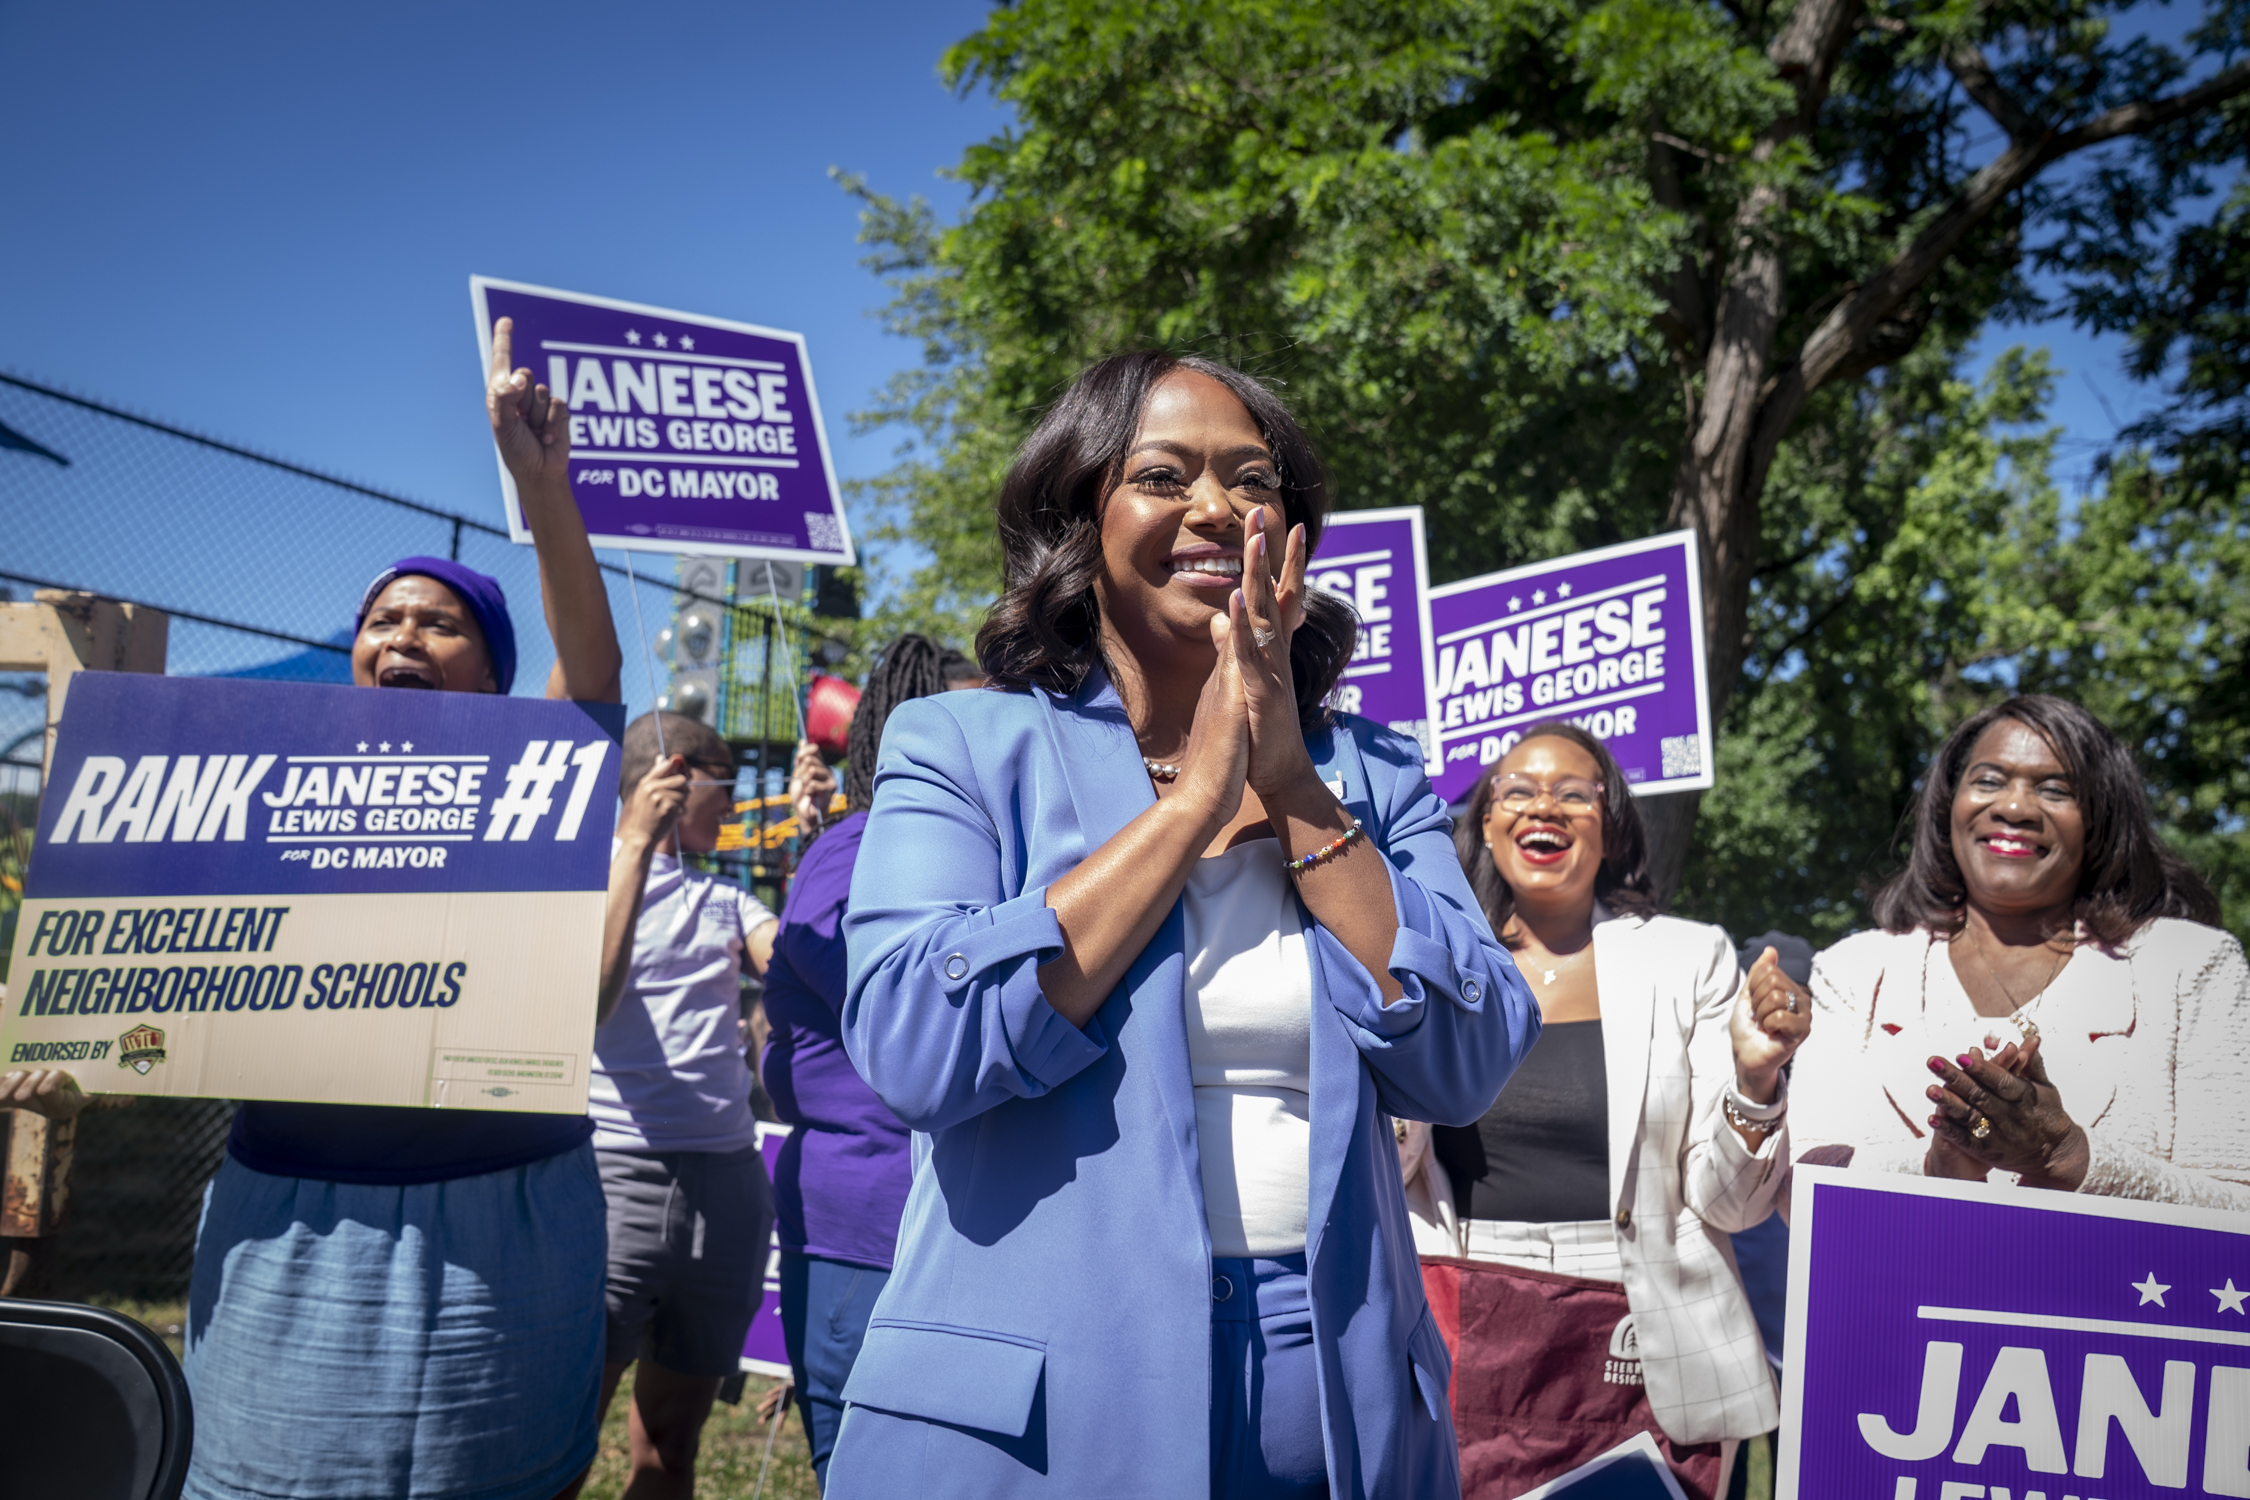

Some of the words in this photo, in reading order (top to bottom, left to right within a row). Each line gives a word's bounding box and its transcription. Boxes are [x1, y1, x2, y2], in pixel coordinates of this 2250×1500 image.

[569, 415, 660, 448] EWIS
[666, 420, 798, 454] GEORGE
[576, 469, 615, 485] FOR
[618, 467, 666, 498] DC
[669, 469, 780, 500] MAYOR
[1436, 587, 1667, 700] JANEESE
[1531, 645, 1666, 706] GEORGE
[1446, 742, 1480, 763] FOR
[1526, 705, 1638, 741] YOR
[48, 754, 278, 844] RANK
[262, 764, 488, 808] JANEESE
[483, 740, 610, 842] #1
[268, 809, 357, 833] LEWIS
[364, 807, 479, 832] GEORGE
[280, 849, 311, 862] FOR
[310, 847, 349, 869] DC
[351, 846, 448, 869] MAYOR
[27, 909, 104, 957] FOR
[102, 907, 290, 955] EXCELLENT
[19, 964, 303, 1017] NEIGHBORHOOD
[304, 962, 468, 1010] SCHOOLS
[10, 1041, 91, 1063] ENDORSED
[90, 1040, 114, 1060] BY
[1603, 1371, 1644, 1386] DESIG
[1605, 1360, 1641, 1375] SIERR
